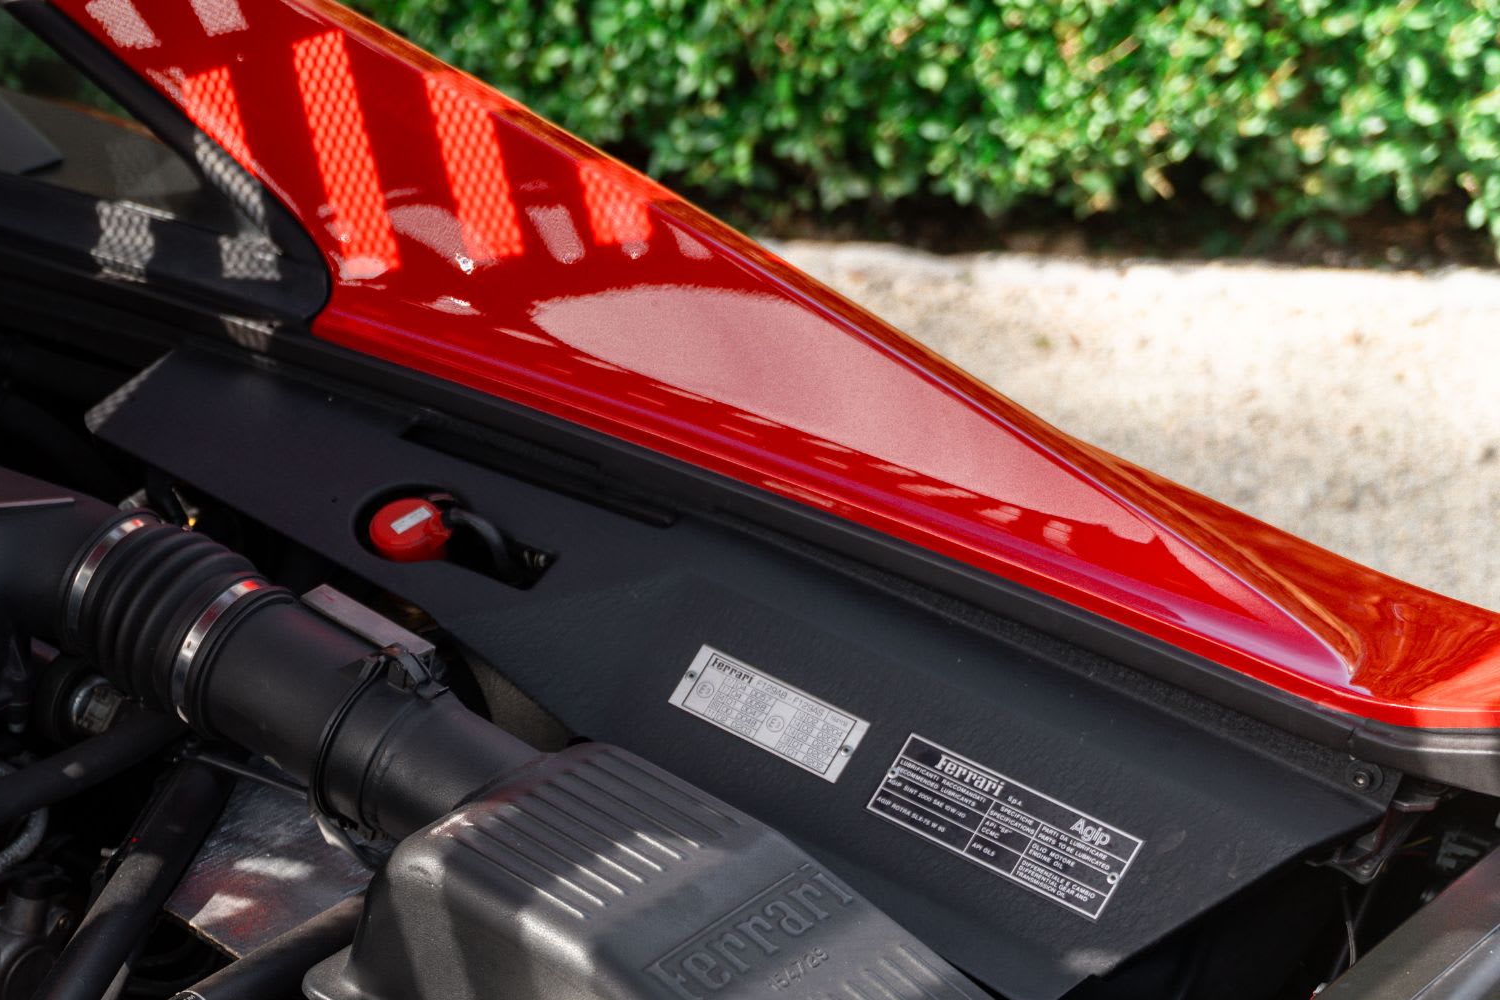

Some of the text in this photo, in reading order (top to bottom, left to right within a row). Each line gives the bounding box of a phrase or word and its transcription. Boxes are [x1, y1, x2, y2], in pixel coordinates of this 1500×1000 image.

[710, 657, 755, 684] Ferrari
[899, 758, 986, 803] LUBRIFICANTI RACCOMANDATI
[933, 753, 1006, 797] Ferrari
[875, 795, 891, 806] AGIP
[890, 802, 911, 816] ROTRA
[886, 776, 903, 788] AGIP
[902, 784, 918, 795] SINT
[916, 791, 933, 802] 2000
[931, 798, 944, 808] SAE
[939, 786, 976, 807] LUBRICANTS
[984, 819, 997, 829] API
[988, 809, 1035, 835] SPECIFICATIONS
[999, 805, 1034, 825] SPECIFICHE
[971, 841, 983, 850] API
[980, 826, 1000, 839] CCMC
[1041, 825, 1107, 860] PARTI DA LUBRIFICARE
[1066, 815, 1114, 850] Agip
[1027, 848, 1064, 869] ENGINE OIL
[1031, 842, 1076, 867] OLIO MOTORE
[1036, 832, 1110, 871] PARTS TO BE LUBRICATED
[1014, 870, 1066, 898] TRANSMISSION OIL
[1017, 864, 1088, 902] DIFFERENTIAL GEAR AND
[1020, 859, 1064, 884] DIFFERENZIALE
[1070, 883, 1096, 899] CAMBIO
